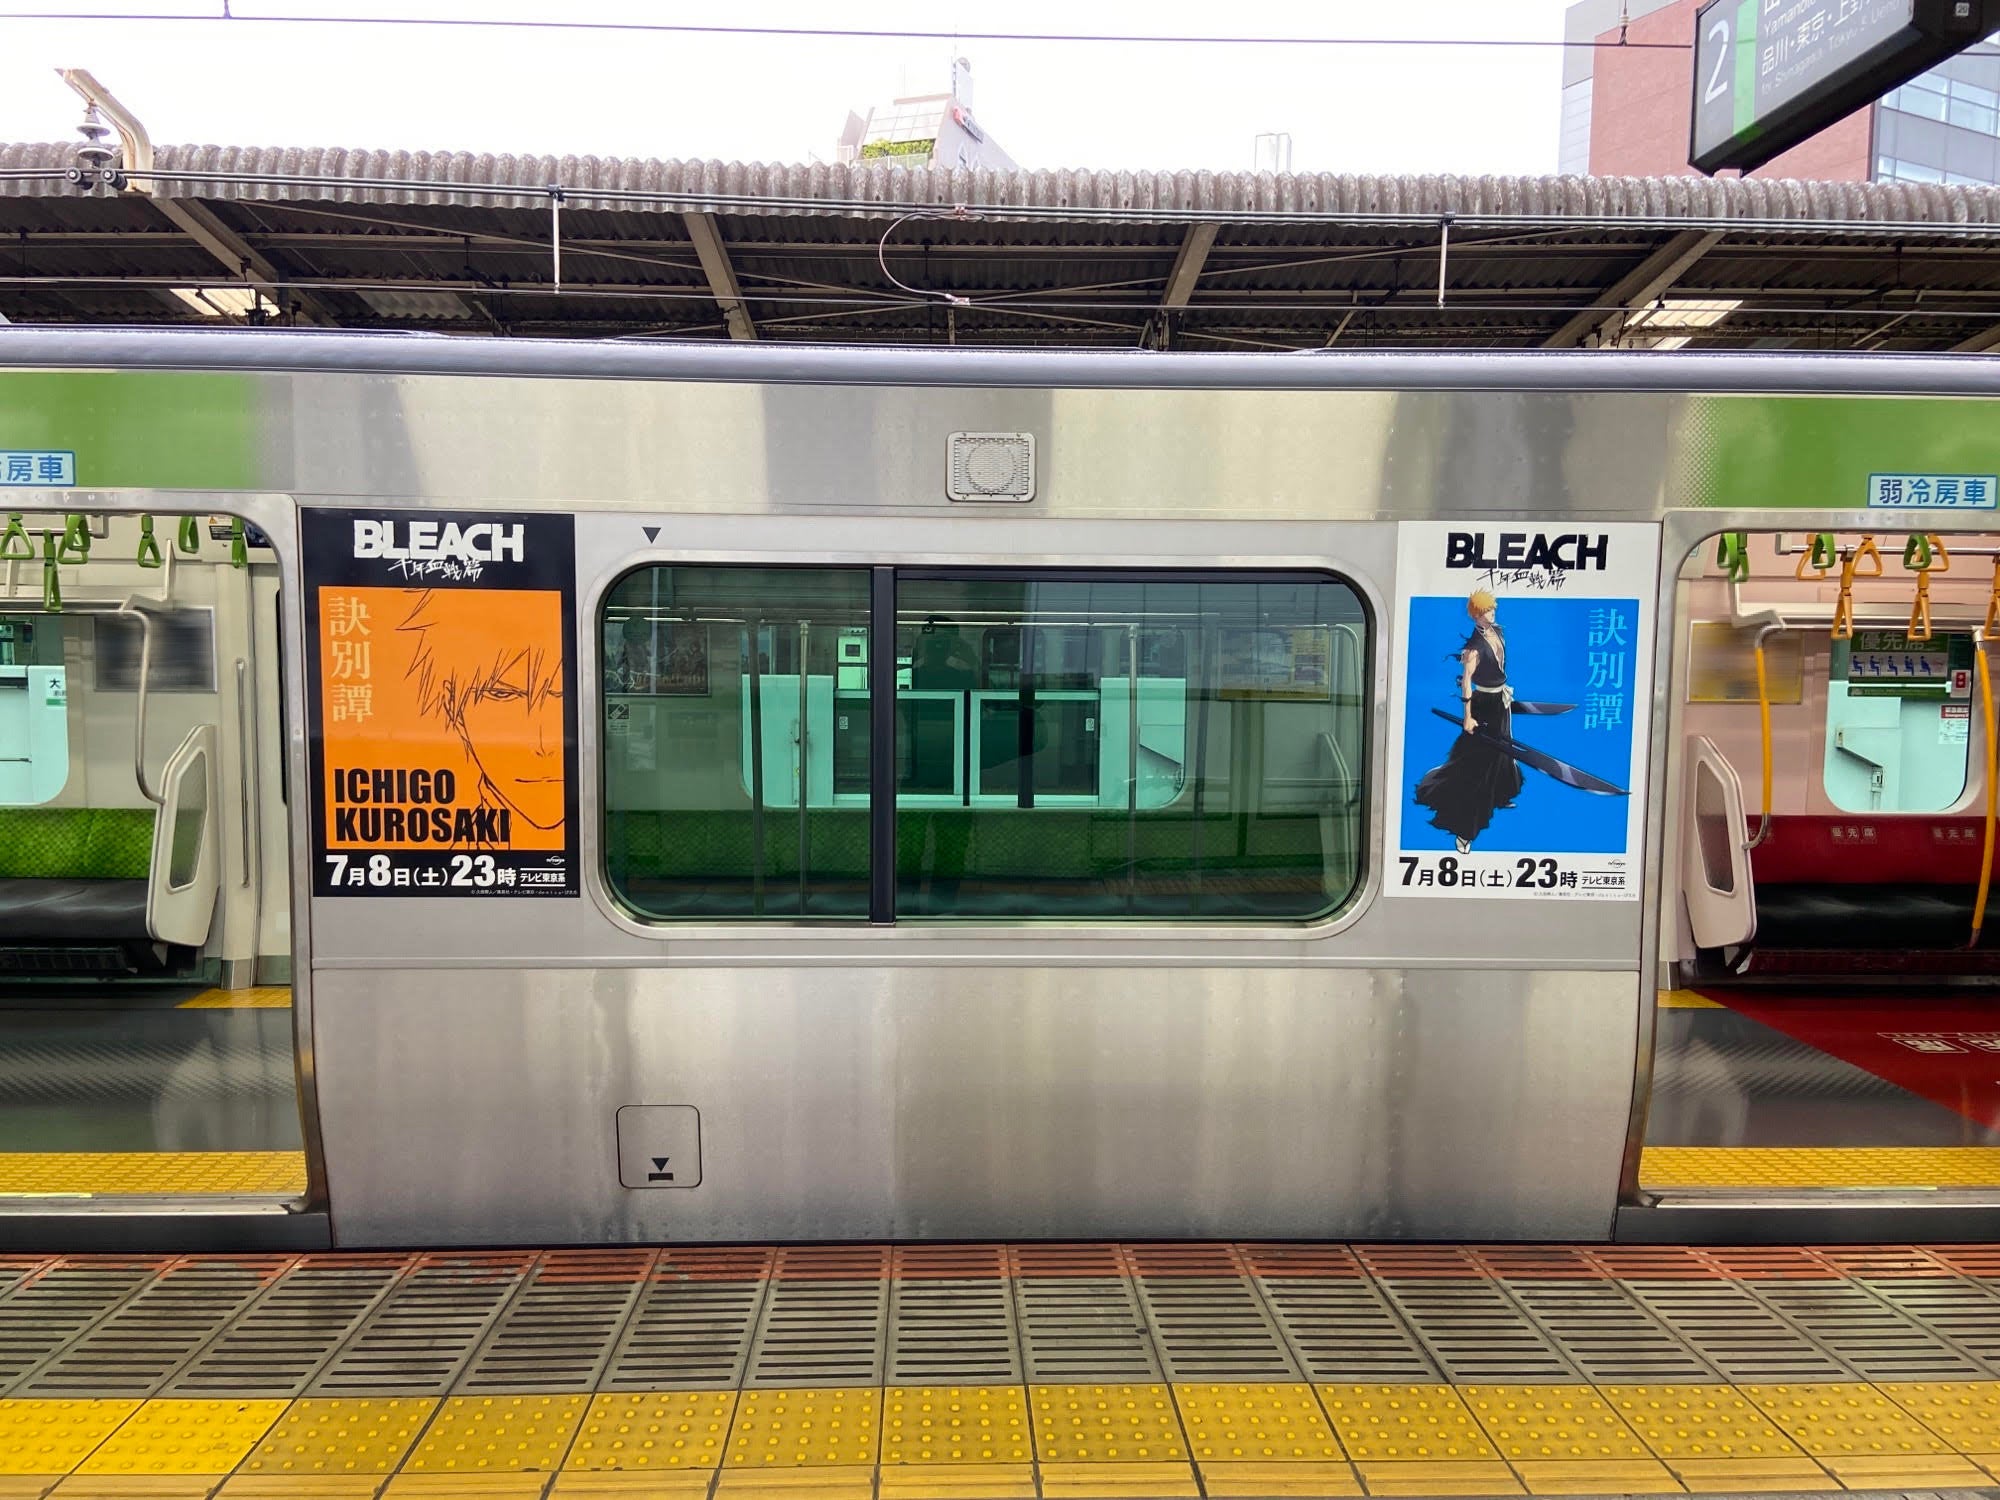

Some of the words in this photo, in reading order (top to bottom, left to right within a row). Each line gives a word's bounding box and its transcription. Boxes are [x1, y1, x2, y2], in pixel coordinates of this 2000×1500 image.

[1704, 20, 1729, 105] 2
[0, 454, 63, 482] 房車
[1879, 478, 1987, 505] 弱冷房車
[353, 519, 525, 562] BLEACH
[1446, 532, 1608, 571] BLEACH
[327, 596, 374, 723] 訣別譚
[1584, 607, 1628, 731] 訣別譚
[334, 768, 456, 805] ICHIGO
[335, 807, 511, 844] KUROSAKI
[325, 854, 517, 887] 7月8日(土)23時
[520, 872, 566, 883] テレビ東京系
[1399, 856, 1578, 889] 7月8日(土)23時
[1582, 876, 1626, 886] テレビ東京系
